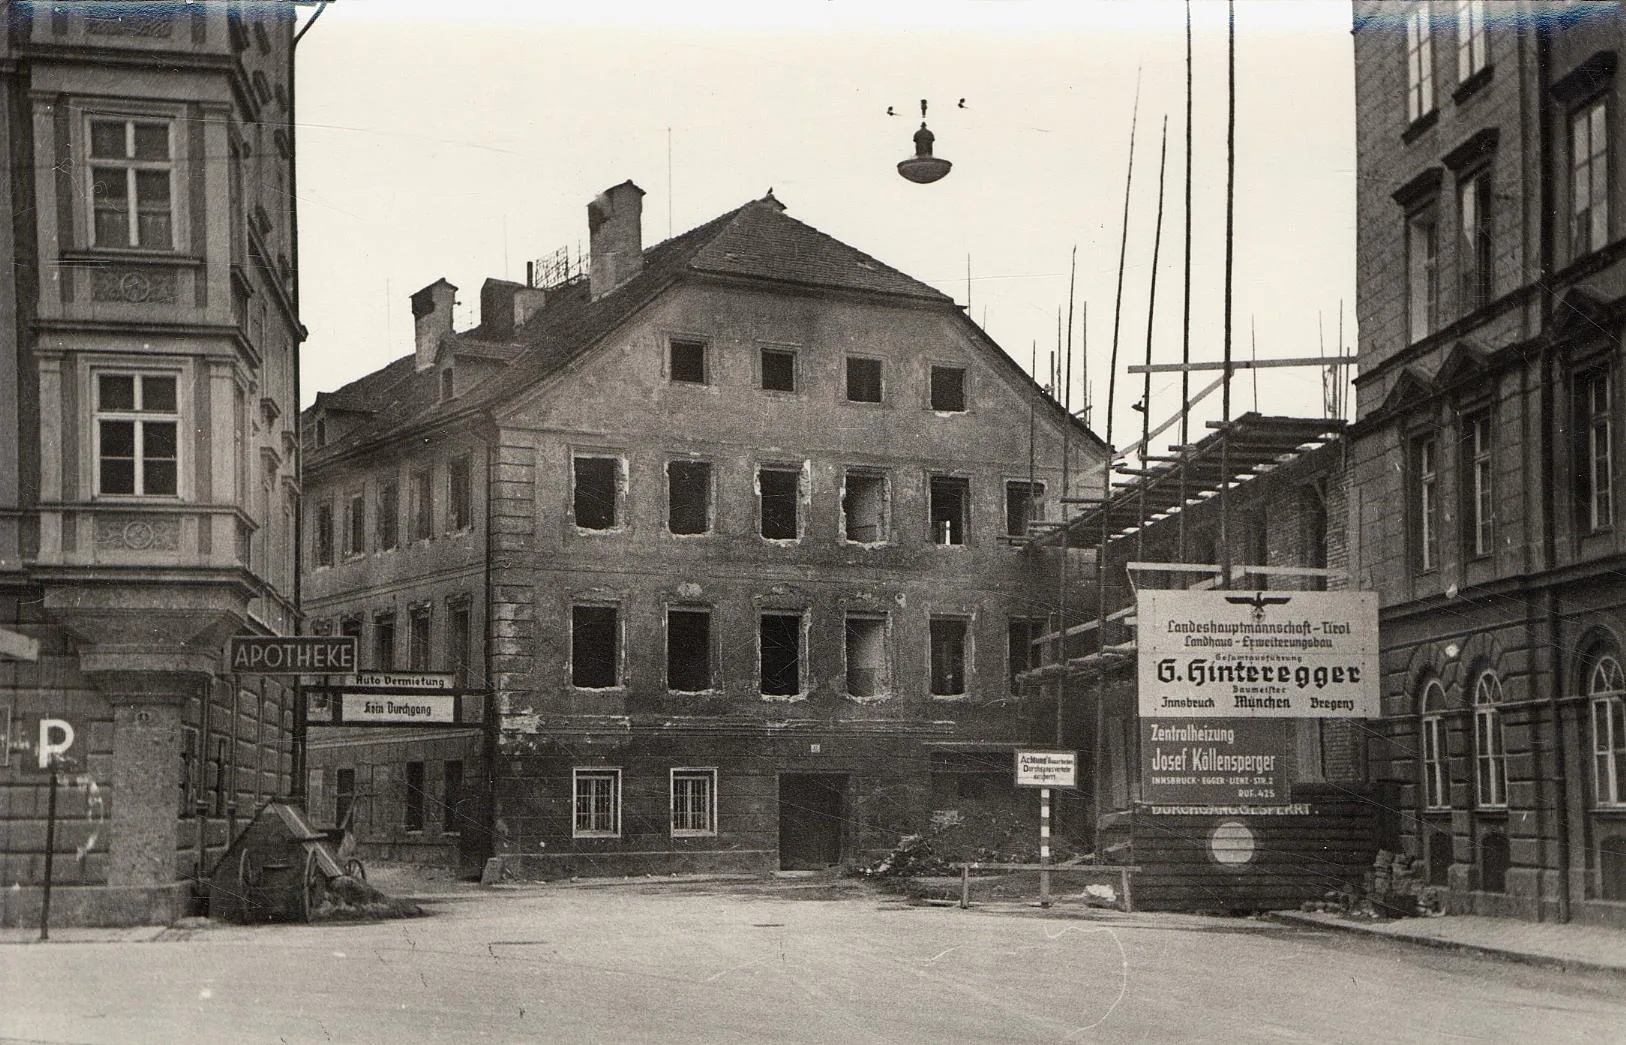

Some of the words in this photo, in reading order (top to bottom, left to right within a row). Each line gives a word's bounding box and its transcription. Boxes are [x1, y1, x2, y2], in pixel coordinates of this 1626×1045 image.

[234, 643, 352, 668] APOTHEKE
[356, 674, 381, 685] Auto
[384, 675, 445, 689] Vermietung
[1157, 658, 1183, 683] G.
[1187, 658, 1361, 689] Hinteregger
[1232, 685, 1287, 695] Baumeister
[364, 701, 384, 714] Kein
[387, 701, 432, 717] Durchgang
[1161, 696, 1215, 708] Innsbruck
[1233, 695, 1291, 709] München
[1310, 697, 1355, 710] Bregenz
[39, 719, 75, 769] P
[1151, 723, 1235, 745] Zentralheizung
[1152, 747, 1188, 771] Josef
[1192, 747, 1276, 774] Köllensperger
